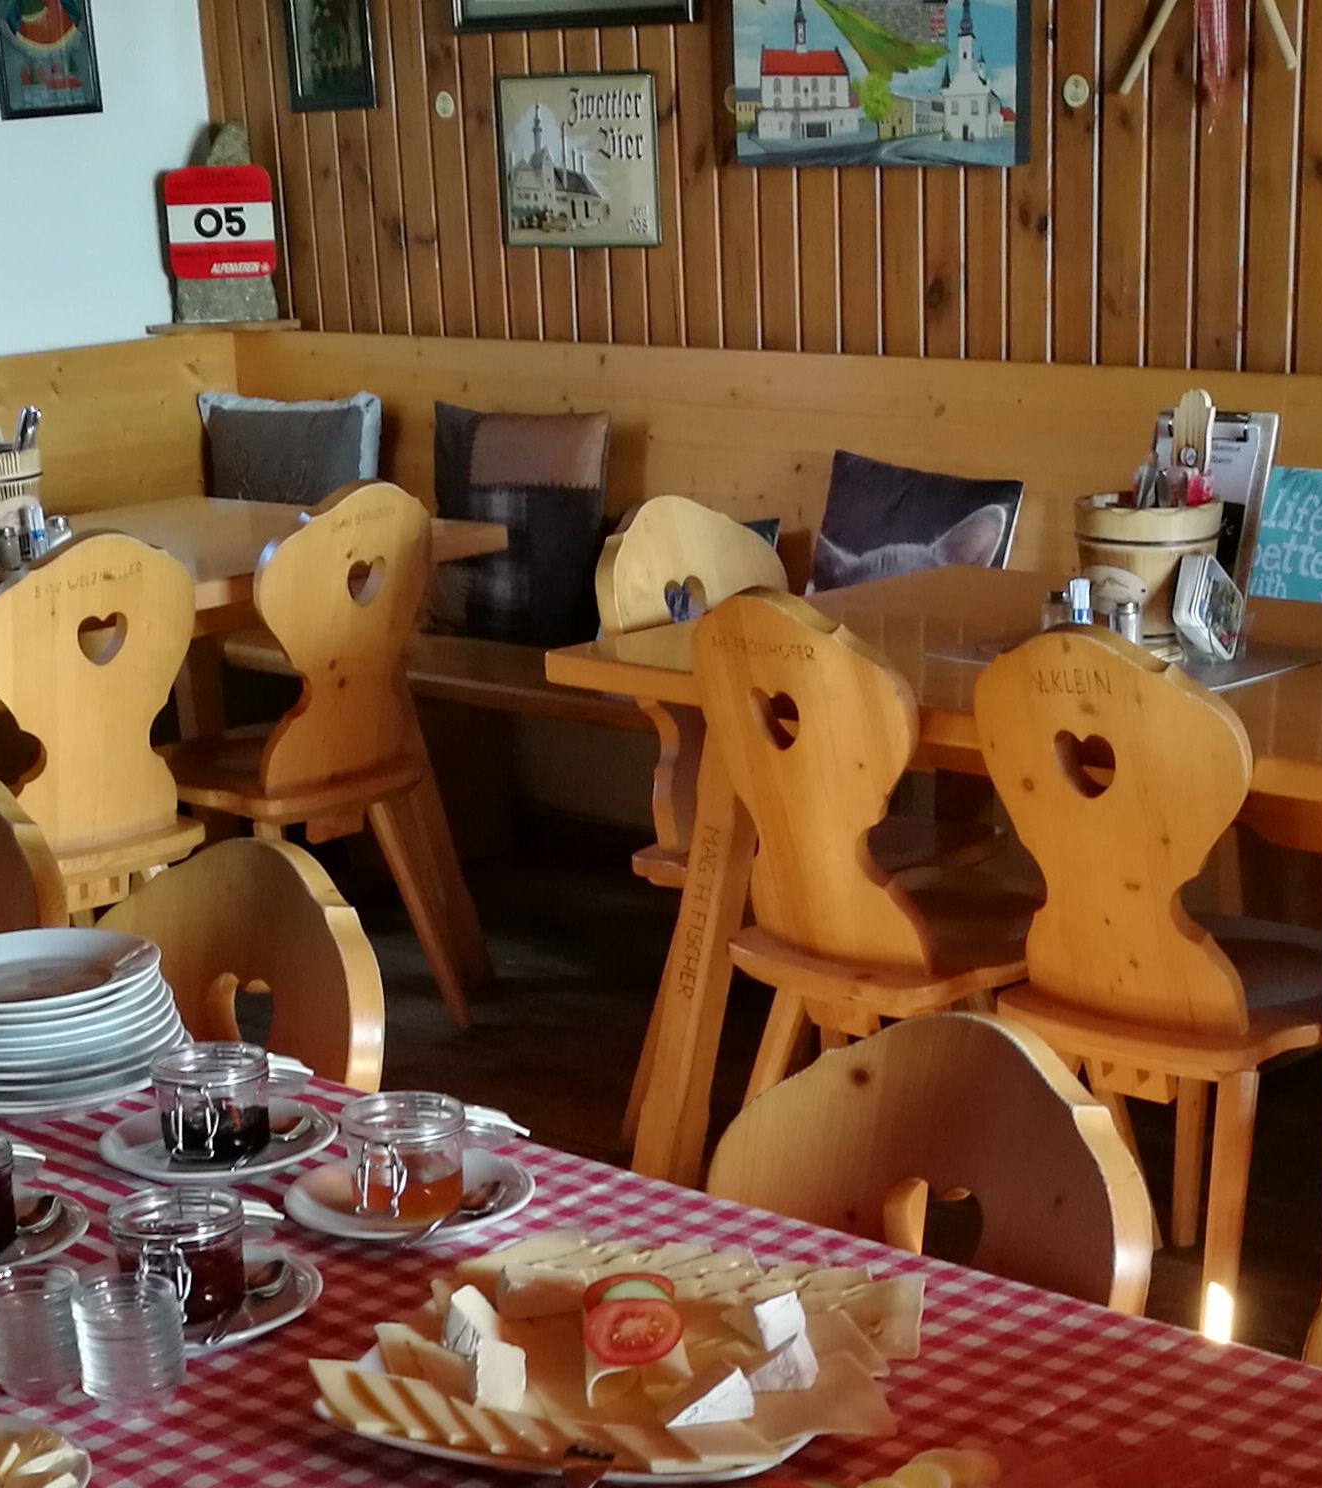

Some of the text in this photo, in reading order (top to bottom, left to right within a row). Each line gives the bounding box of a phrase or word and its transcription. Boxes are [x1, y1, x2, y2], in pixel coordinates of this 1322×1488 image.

[567, 88, 642, 126] Zwettler
[598, 127, 645, 160] Bier
[210, 261, 262, 274] ALPENVEREIN
[678, 911, 707, 999] FISCHER
